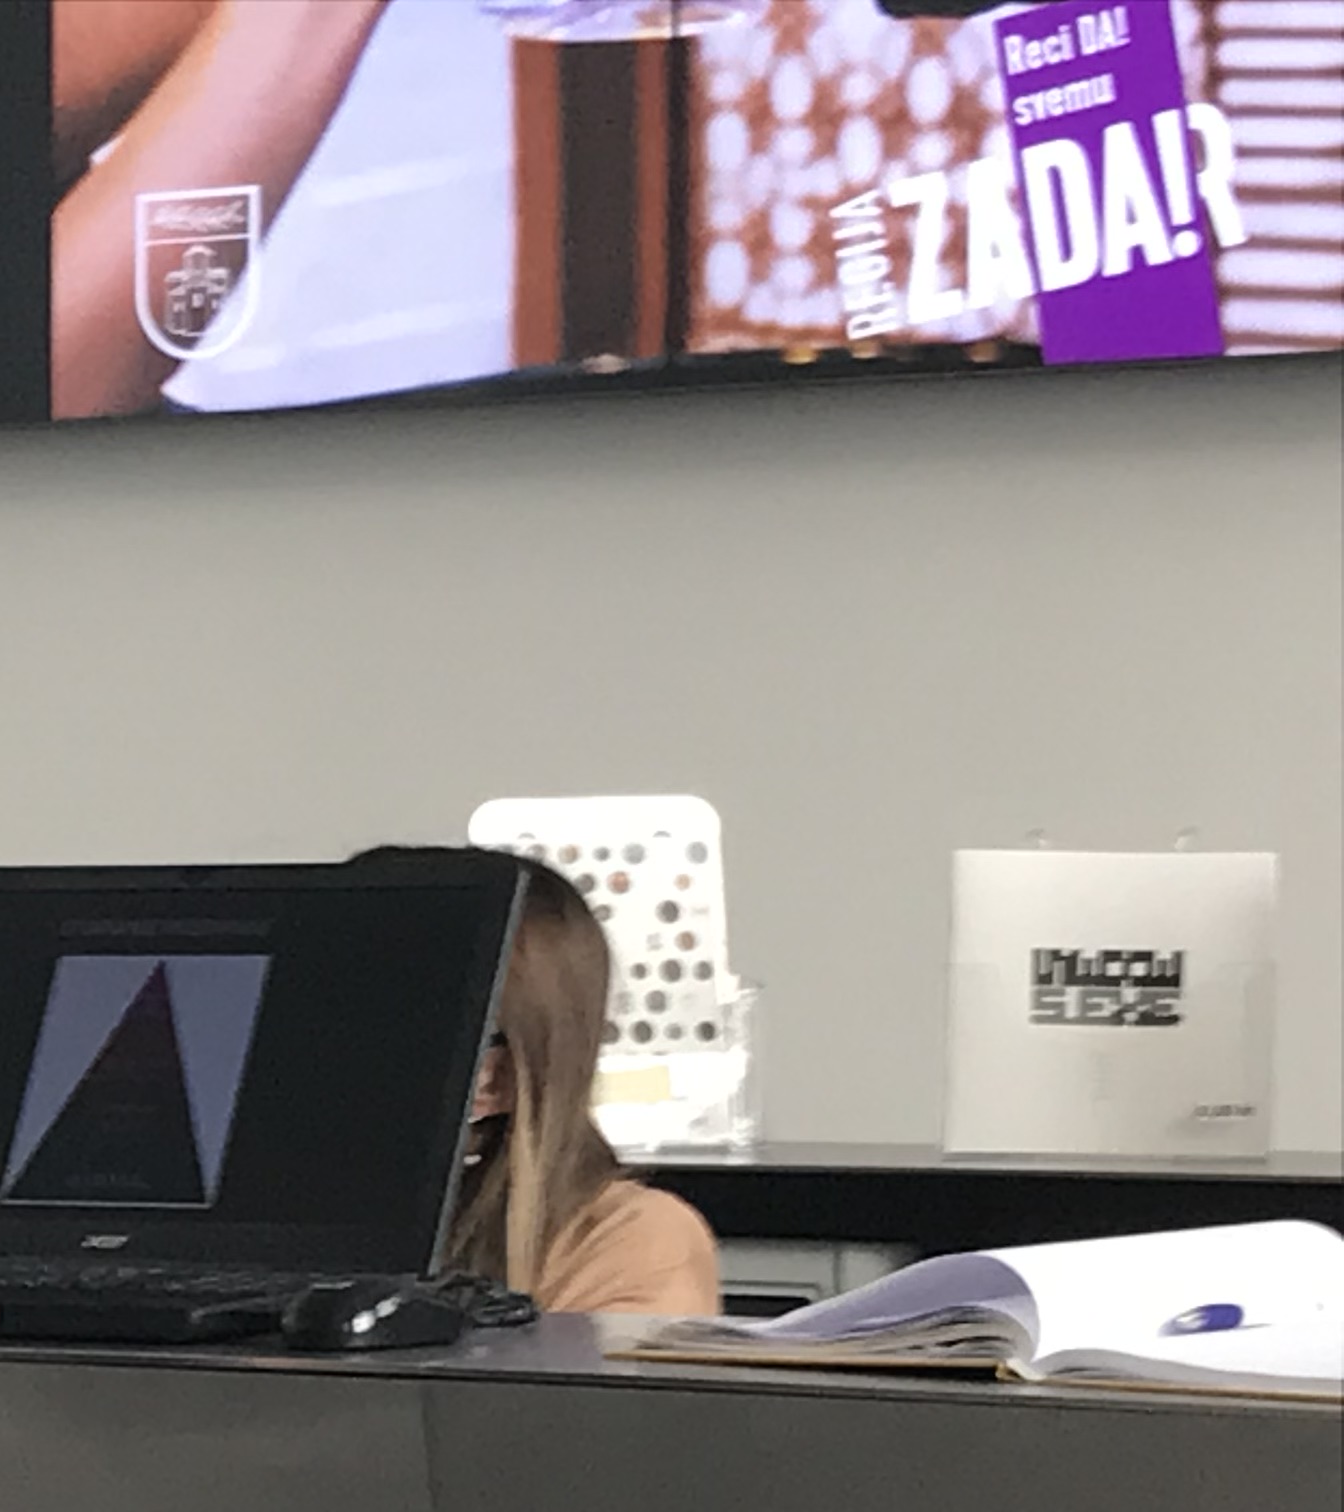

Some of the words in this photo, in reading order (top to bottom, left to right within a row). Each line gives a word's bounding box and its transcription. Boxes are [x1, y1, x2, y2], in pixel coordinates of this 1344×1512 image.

[1004, 25, 1075, 75] Reci
[1076, 6, 1130, 55] DA!
[1013, 73, 1116, 125] svemu
[829, 189, 900, 341] REGIJA
